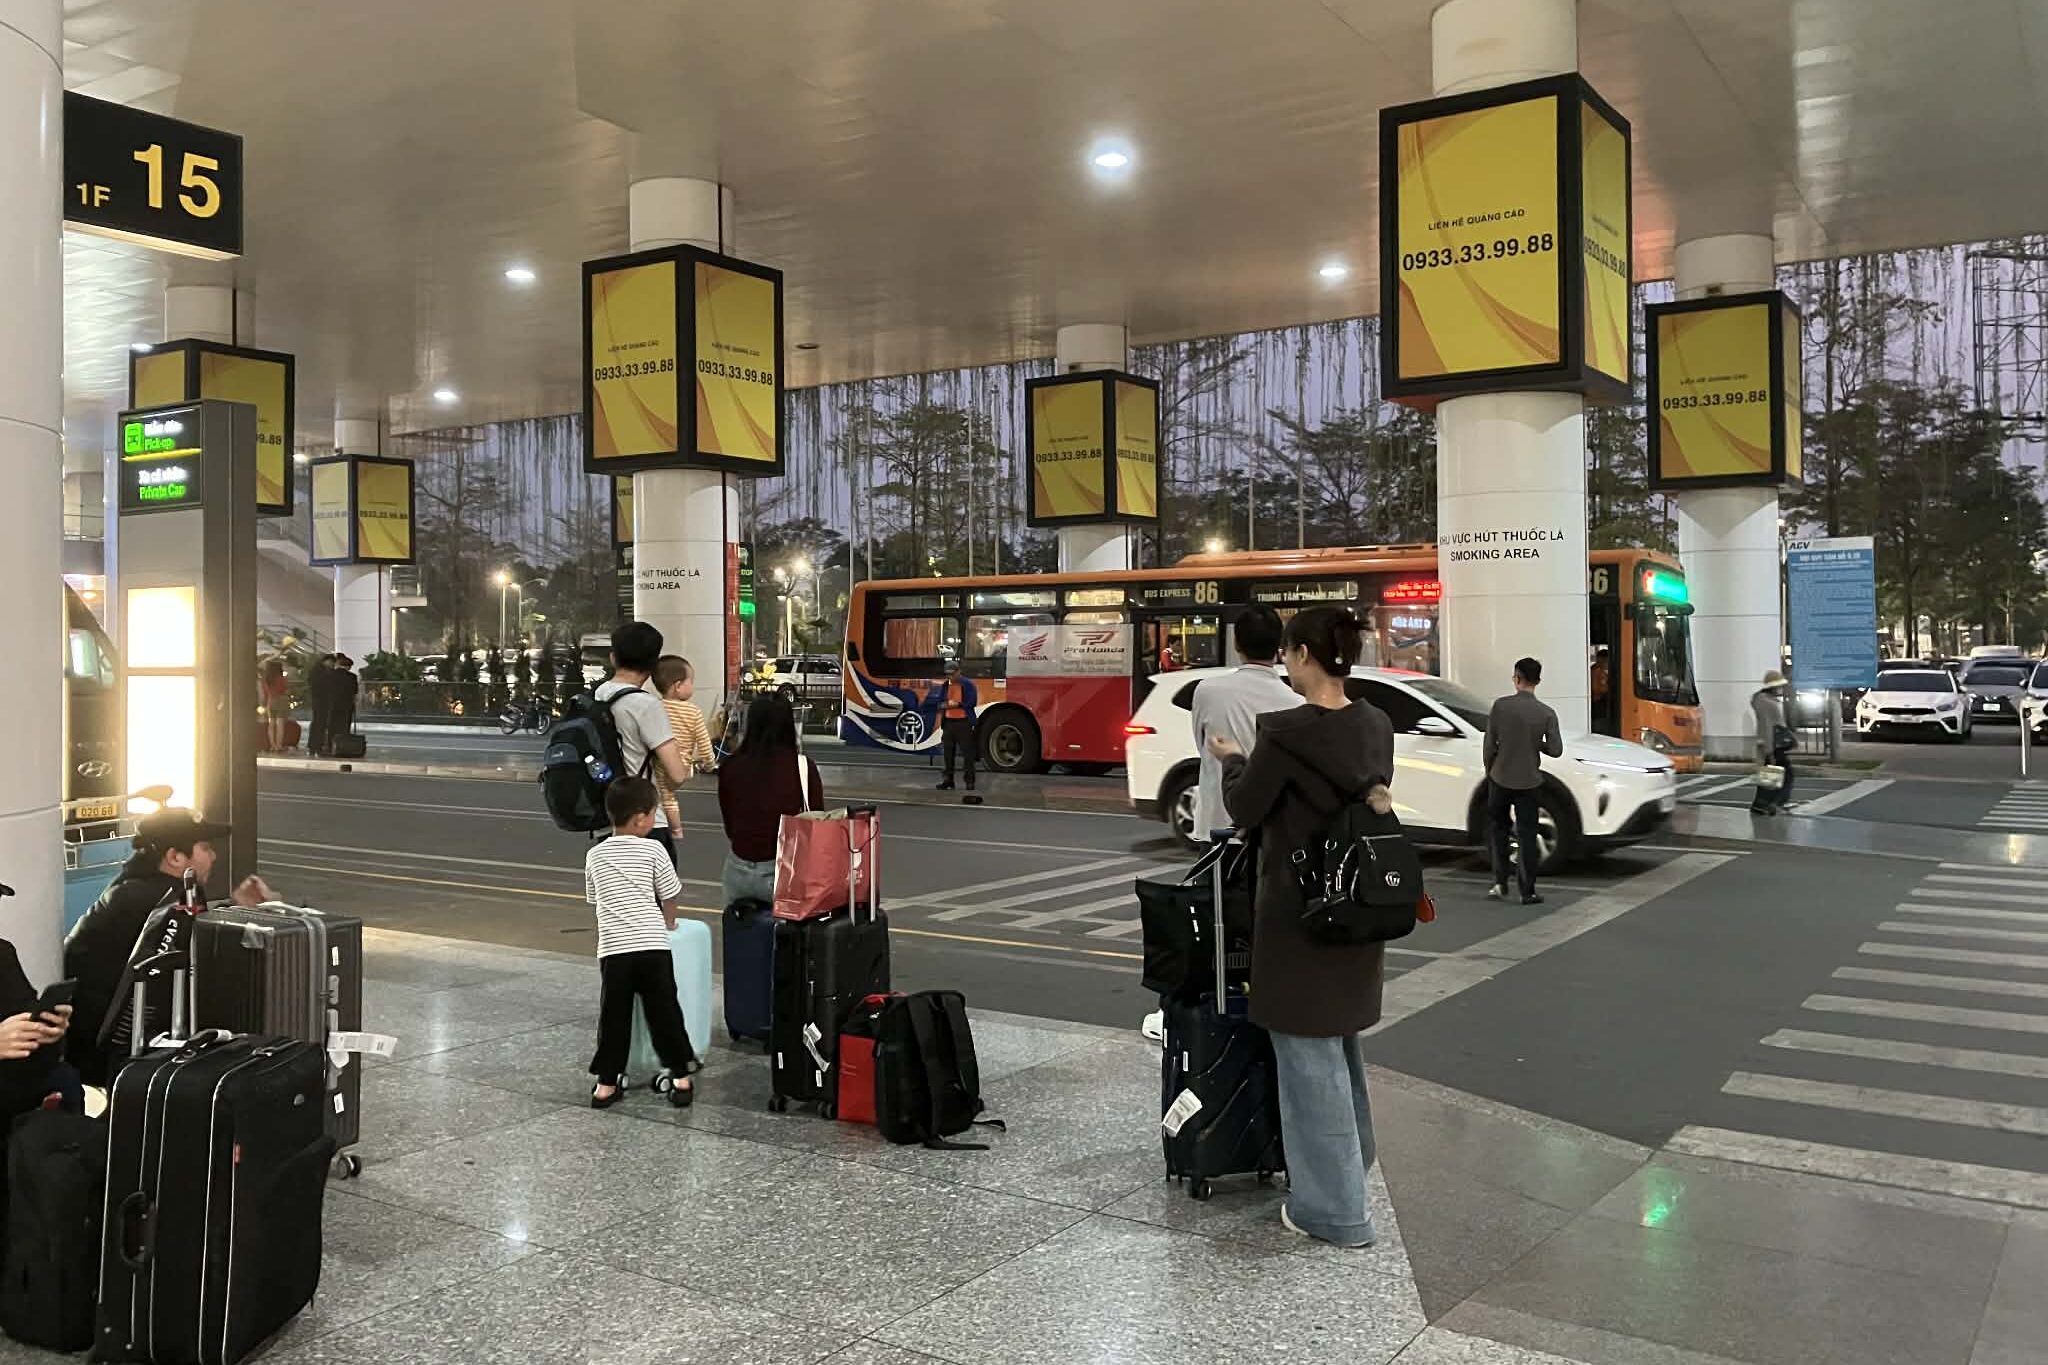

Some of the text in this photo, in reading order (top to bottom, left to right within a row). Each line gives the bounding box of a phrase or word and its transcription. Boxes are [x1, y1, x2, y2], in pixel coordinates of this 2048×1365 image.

[133, 143, 221, 218] 15
[76, 183, 111, 207] 1F
[1402, 233, 1554, 271] 0933.33.99.88
[594, 358, 674, 381] 0933.33.99.88
[698, 359, 773, 386] 0933.33.99.88
[1663, 389, 1767, 410] 0933.33.99.88
[1450, 548, 1540, 562] SMOKING AREA
[656, 581, 681, 590] AREA
[1144, 581, 1218, 604] BUS EXPRESS 86
